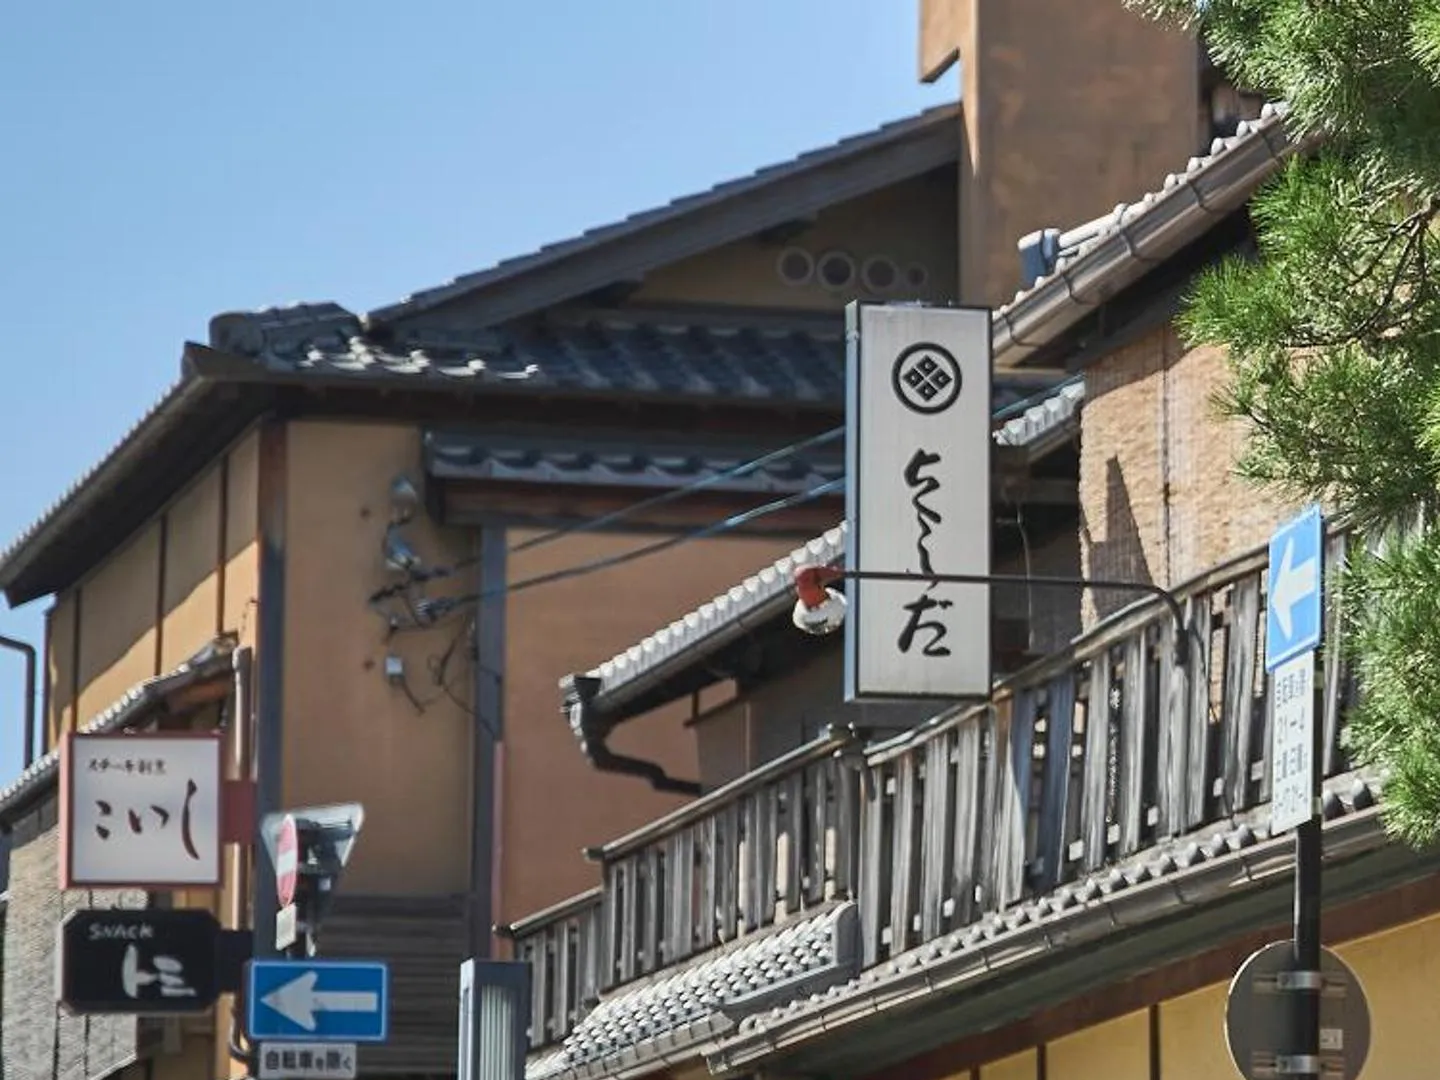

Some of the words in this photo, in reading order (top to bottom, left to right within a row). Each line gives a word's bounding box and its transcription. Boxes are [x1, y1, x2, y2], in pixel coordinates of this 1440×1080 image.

[95, 778, 200, 861] こいし
[88, 922, 154, 941] SNACK
[265, 1050, 352, 1072] 自転車を除く
